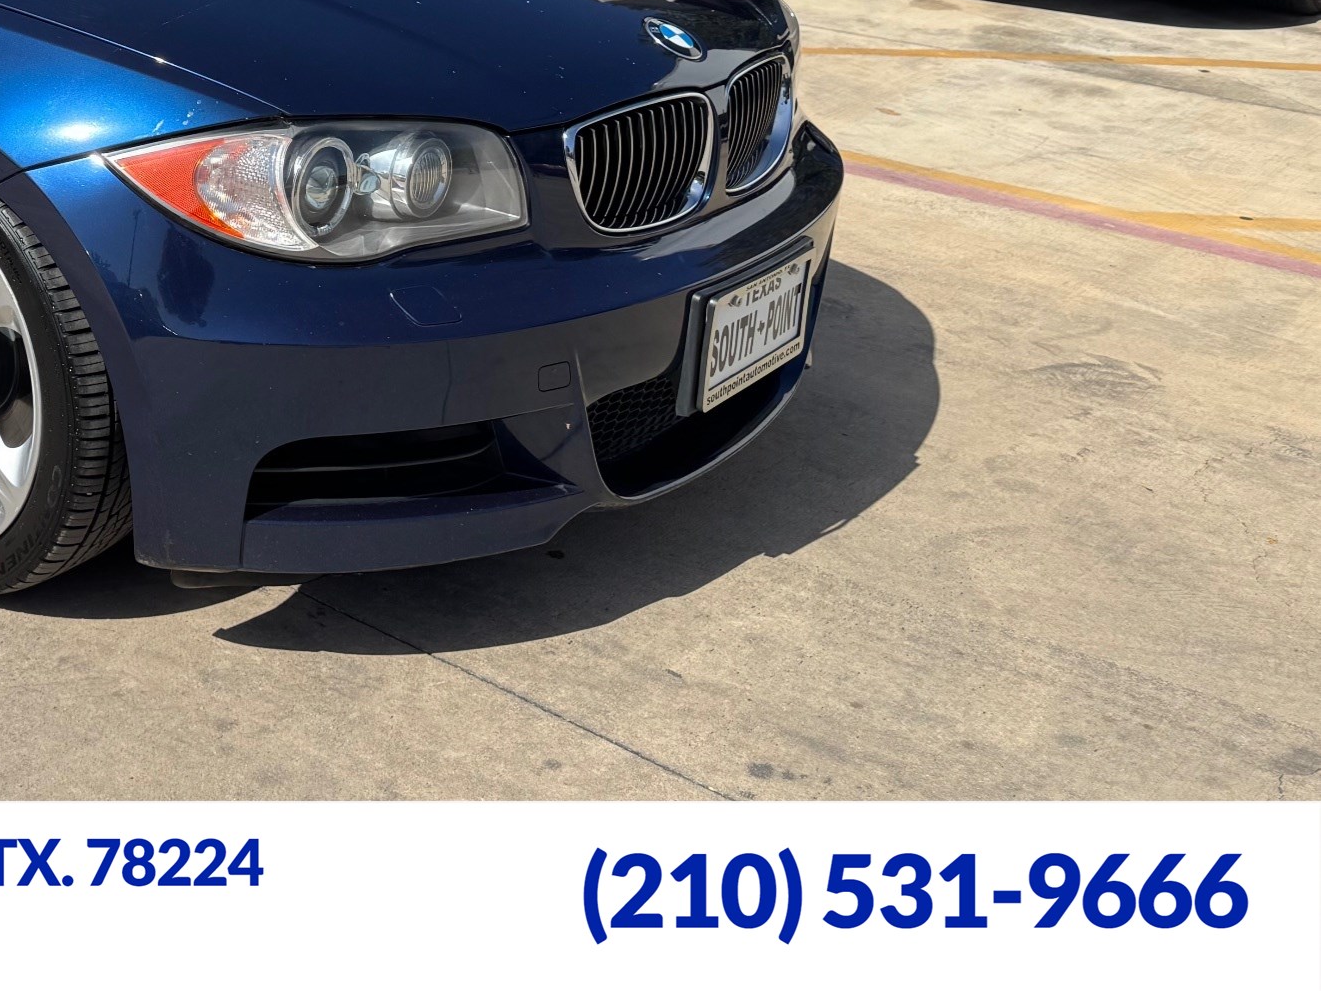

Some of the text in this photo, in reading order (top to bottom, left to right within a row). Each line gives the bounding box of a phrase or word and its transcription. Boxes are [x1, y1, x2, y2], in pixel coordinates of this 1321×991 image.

[745, 277, 782, 307] TEXAS
[709, 282, 803, 378] SOUTH POINT
[706, 341, 801, 407] southpointautomotive.com
